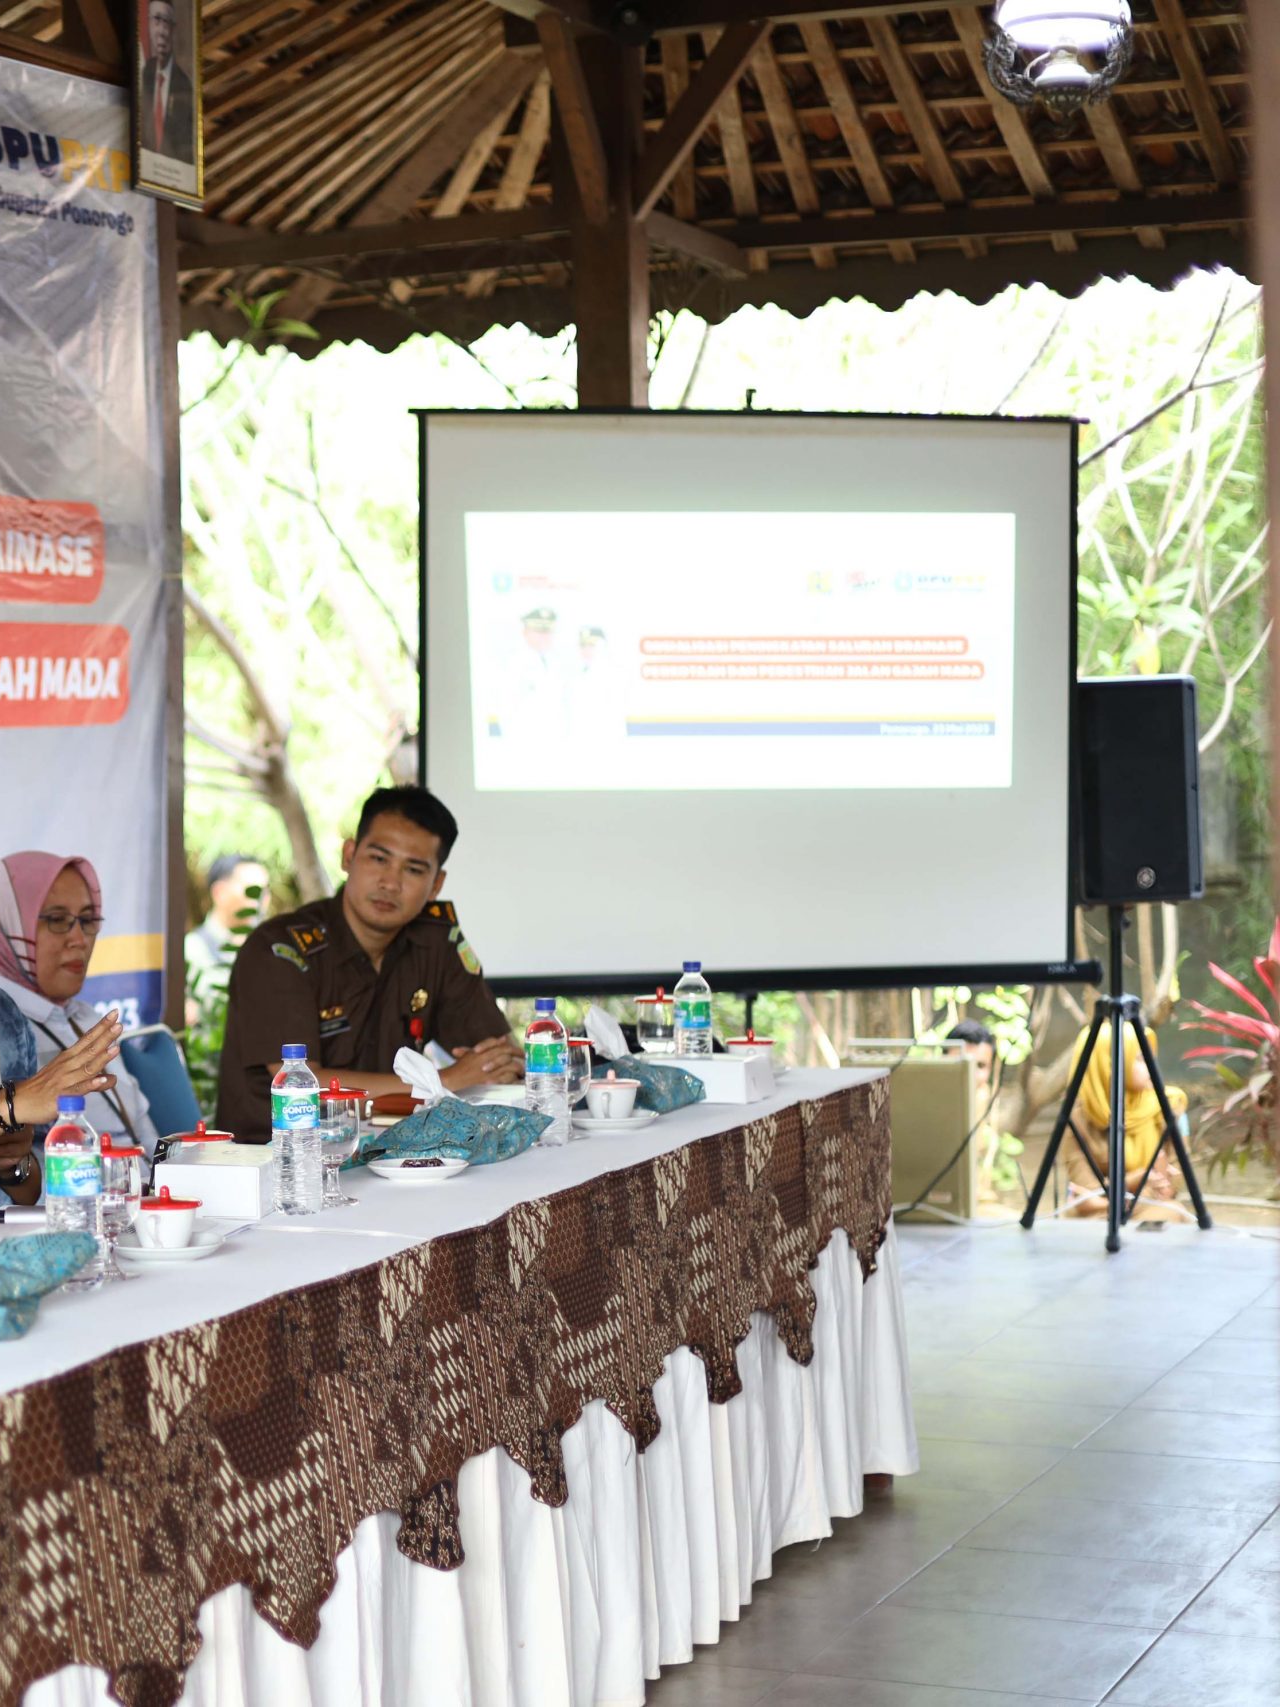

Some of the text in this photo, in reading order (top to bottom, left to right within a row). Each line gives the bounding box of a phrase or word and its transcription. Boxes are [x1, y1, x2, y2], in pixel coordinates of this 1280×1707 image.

[61, 201, 134, 237] Ponorogo
[40, 656, 120, 699] MADA
[64, 1168, 100, 1180] GONTO
